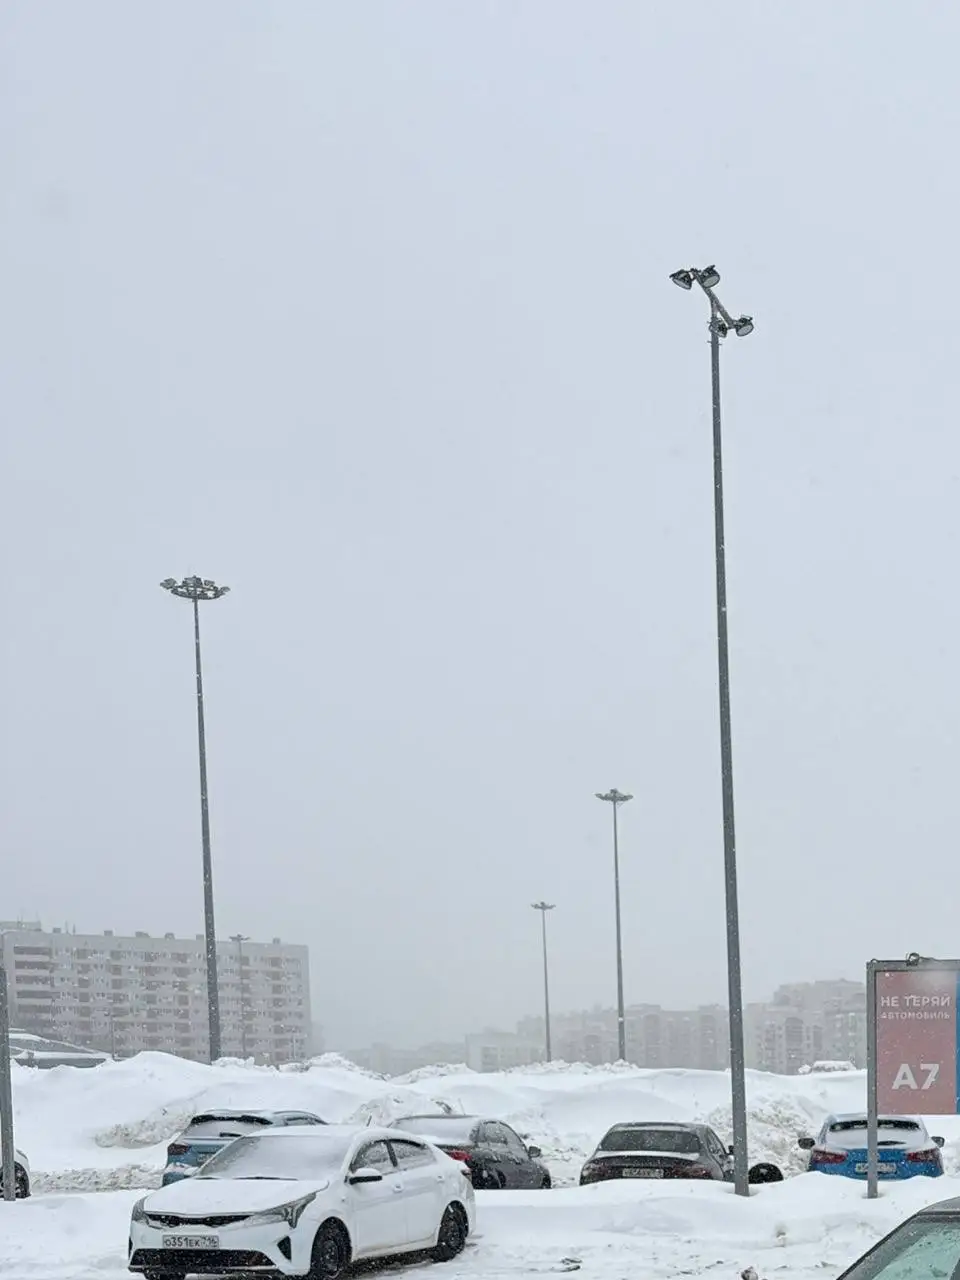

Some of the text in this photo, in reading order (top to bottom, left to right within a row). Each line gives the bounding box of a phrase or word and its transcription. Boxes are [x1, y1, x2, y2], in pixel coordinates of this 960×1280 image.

[880, 993, 951, 1007] НЕ ТЕРЯЙ
[880, 1011, 950, 1019] АВТОМОБИЛЬ
[891, 1063, 940, 1090] А7
